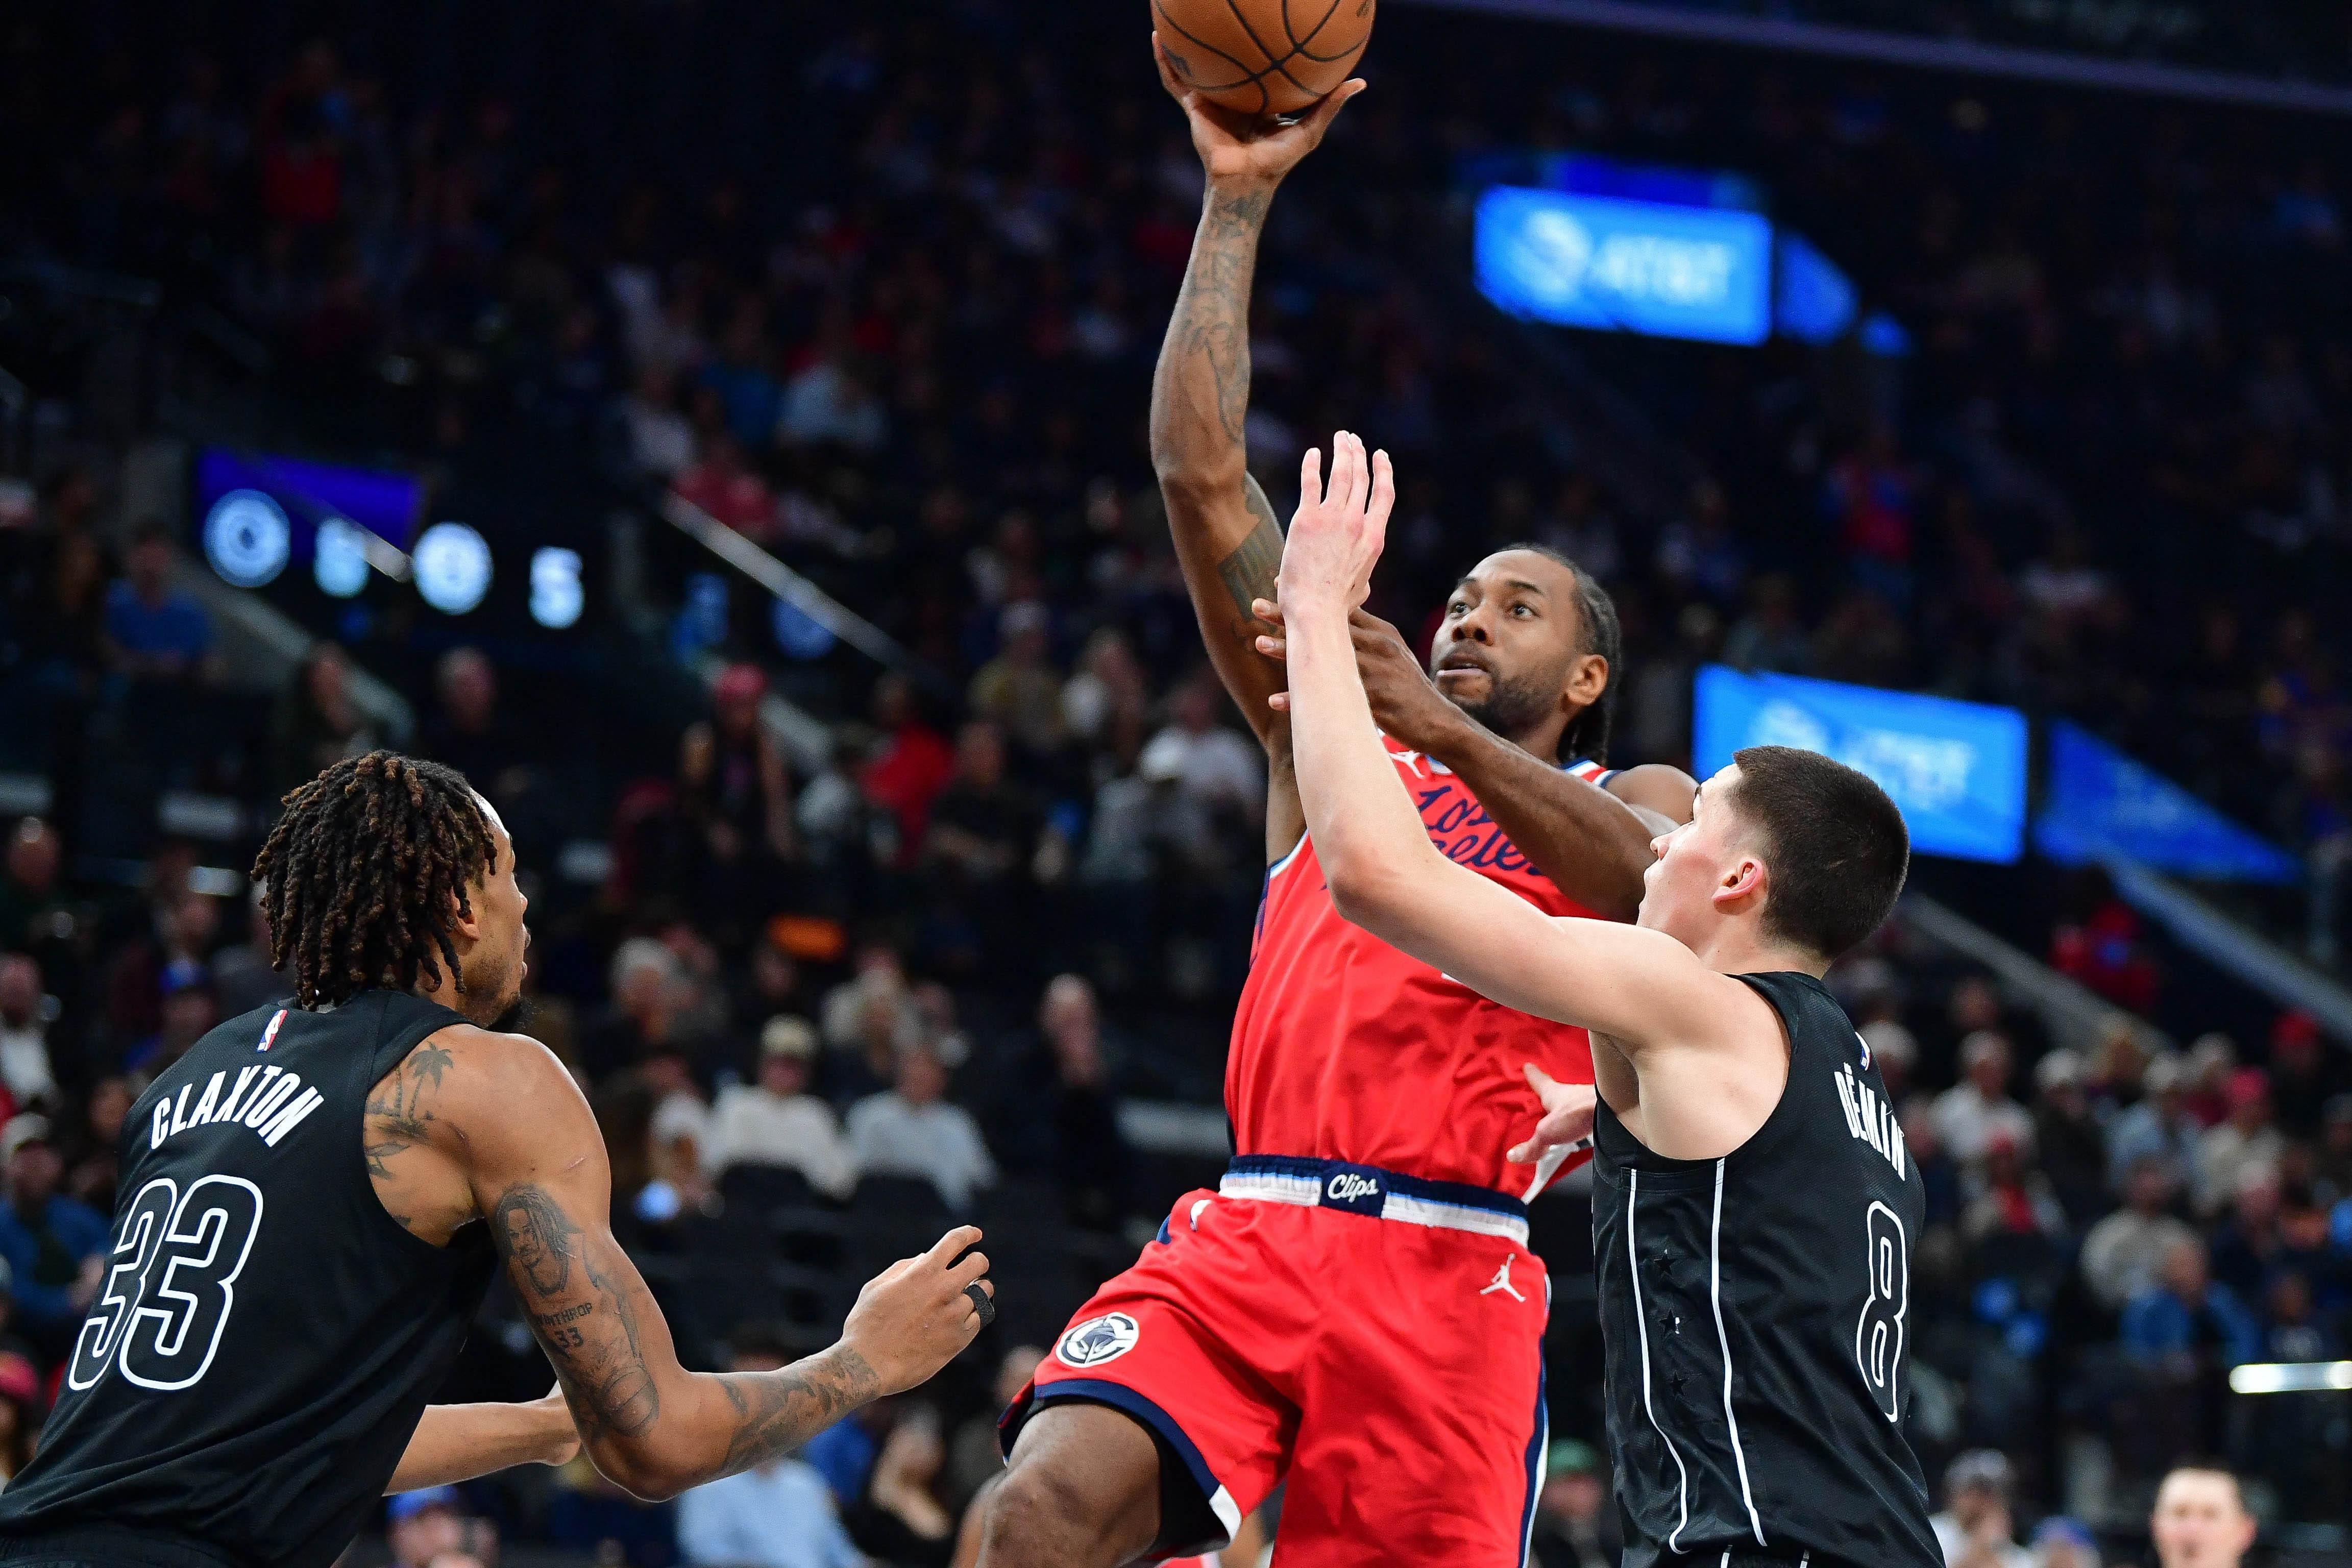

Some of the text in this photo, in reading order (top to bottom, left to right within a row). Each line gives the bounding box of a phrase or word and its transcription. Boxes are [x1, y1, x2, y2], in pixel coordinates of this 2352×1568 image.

[151, 1065, 324, 1149] CLAXTON
[1328, 1173, 1379, 1203] Clips
[68, 1174, 263, 1391] 33
[1856, 1200, 1907, 1423] 8
[554, 1327, 583, 1348] 33
